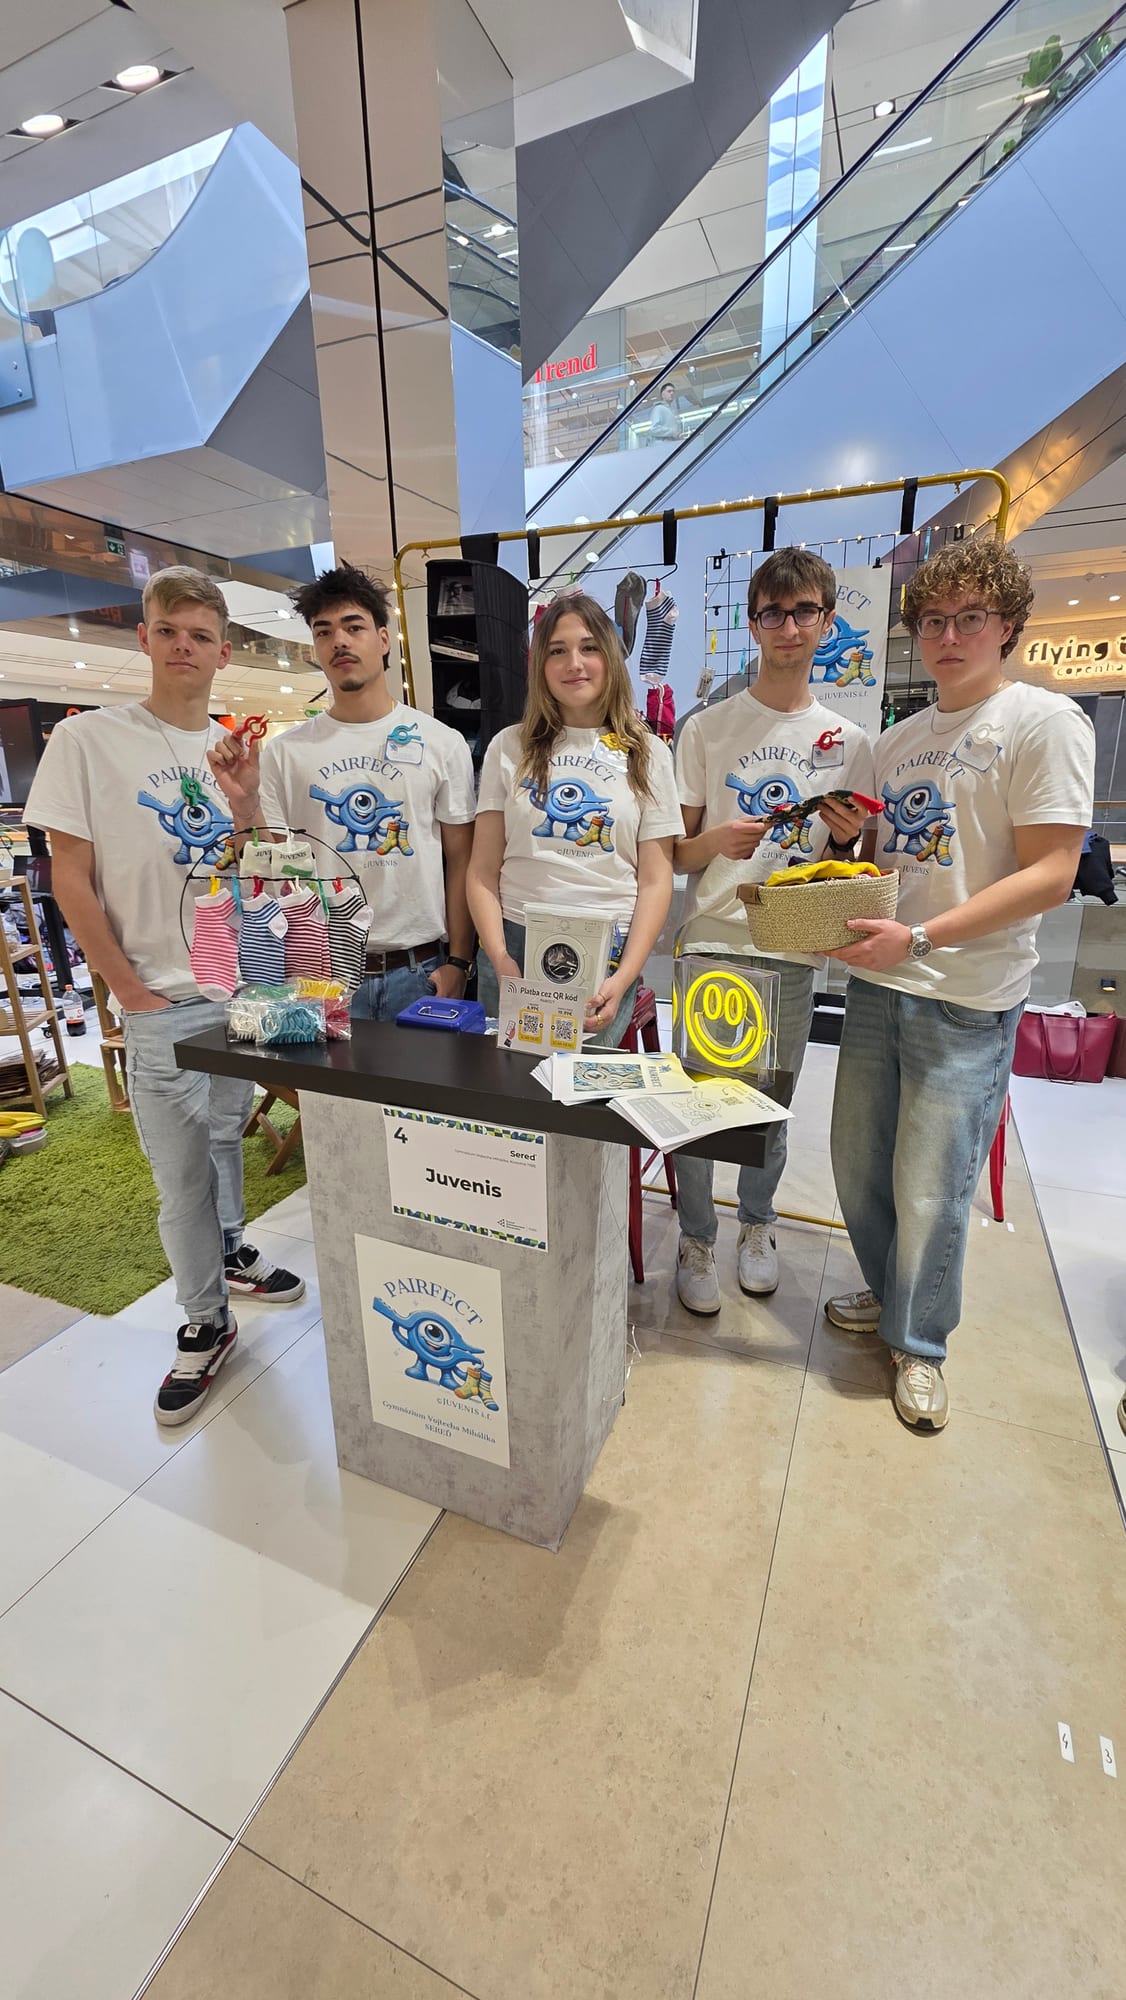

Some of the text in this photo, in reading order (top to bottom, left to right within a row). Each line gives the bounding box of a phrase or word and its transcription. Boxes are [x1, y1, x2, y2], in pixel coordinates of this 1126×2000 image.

[1028, 639, 1109, 665] flying
[318, 756, 403, 781] PAIRFECT
[548, 755, 617, 783] AIRFECT
[738, 746, 818, 779] PAIRFECT
[895, 751, 966, 779] PAIRFECT
[147, 766, 222, 791] PAIRFEC
[520, 987, 540, 996] Platba
[553, 991, 564, 1001] QR
[565, 993, 578, 1002] kód
[393, 1127, 409, 1144] 4
[425, 1167, 503, 1198] Juvenis
[384, 1278, 484, 1325] PAIRFECT
[382, 1401, 496, 1443] Gymnázium Vojtecha Mihálika
[1062, 1733, 1068, 1749] 4
[1104, 1748, 1113, 1764] 3
